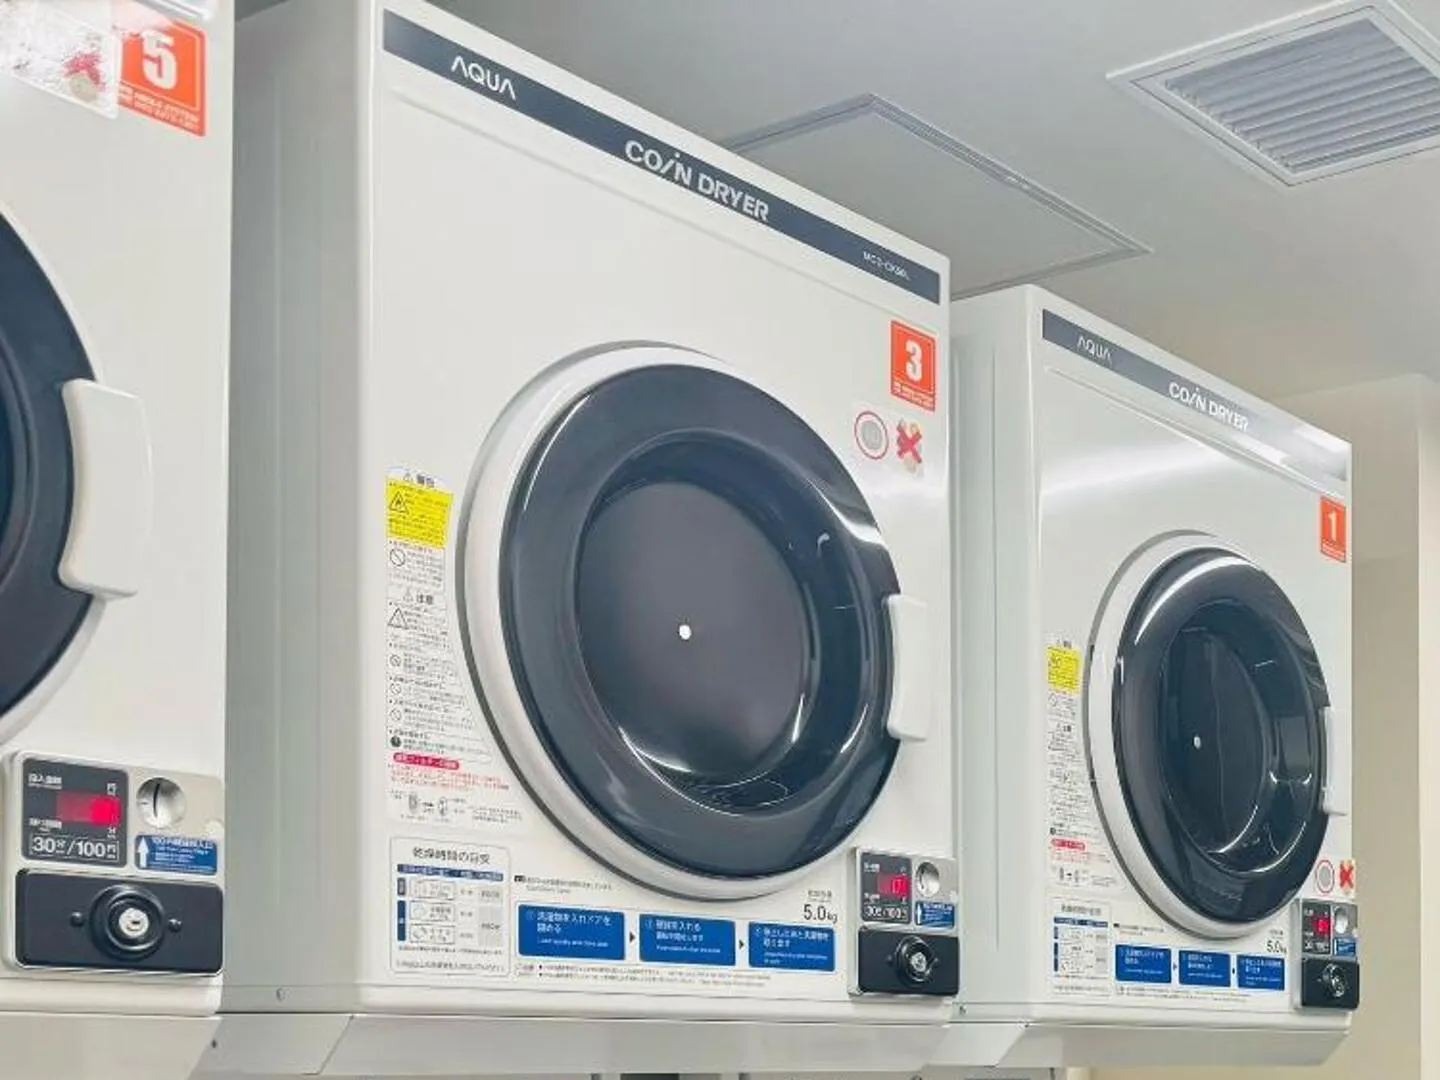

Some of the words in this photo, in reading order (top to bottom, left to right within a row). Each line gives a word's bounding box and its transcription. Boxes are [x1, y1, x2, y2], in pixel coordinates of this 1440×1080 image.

[142, 30, 178, 90] 5
[451, 55, 517, 100] AQUA
[625, 139, 693, 187] COIN
[698, 171, 770, 222] DRYER
[905, 339, 922, 384] 3
[1077, 335, 1112, 365] AQUA
[1169, 381, 1206, 413] COIN
[1209, 400, 1249, 432] DRYER
[1328, 510, 1338, 541] 1
